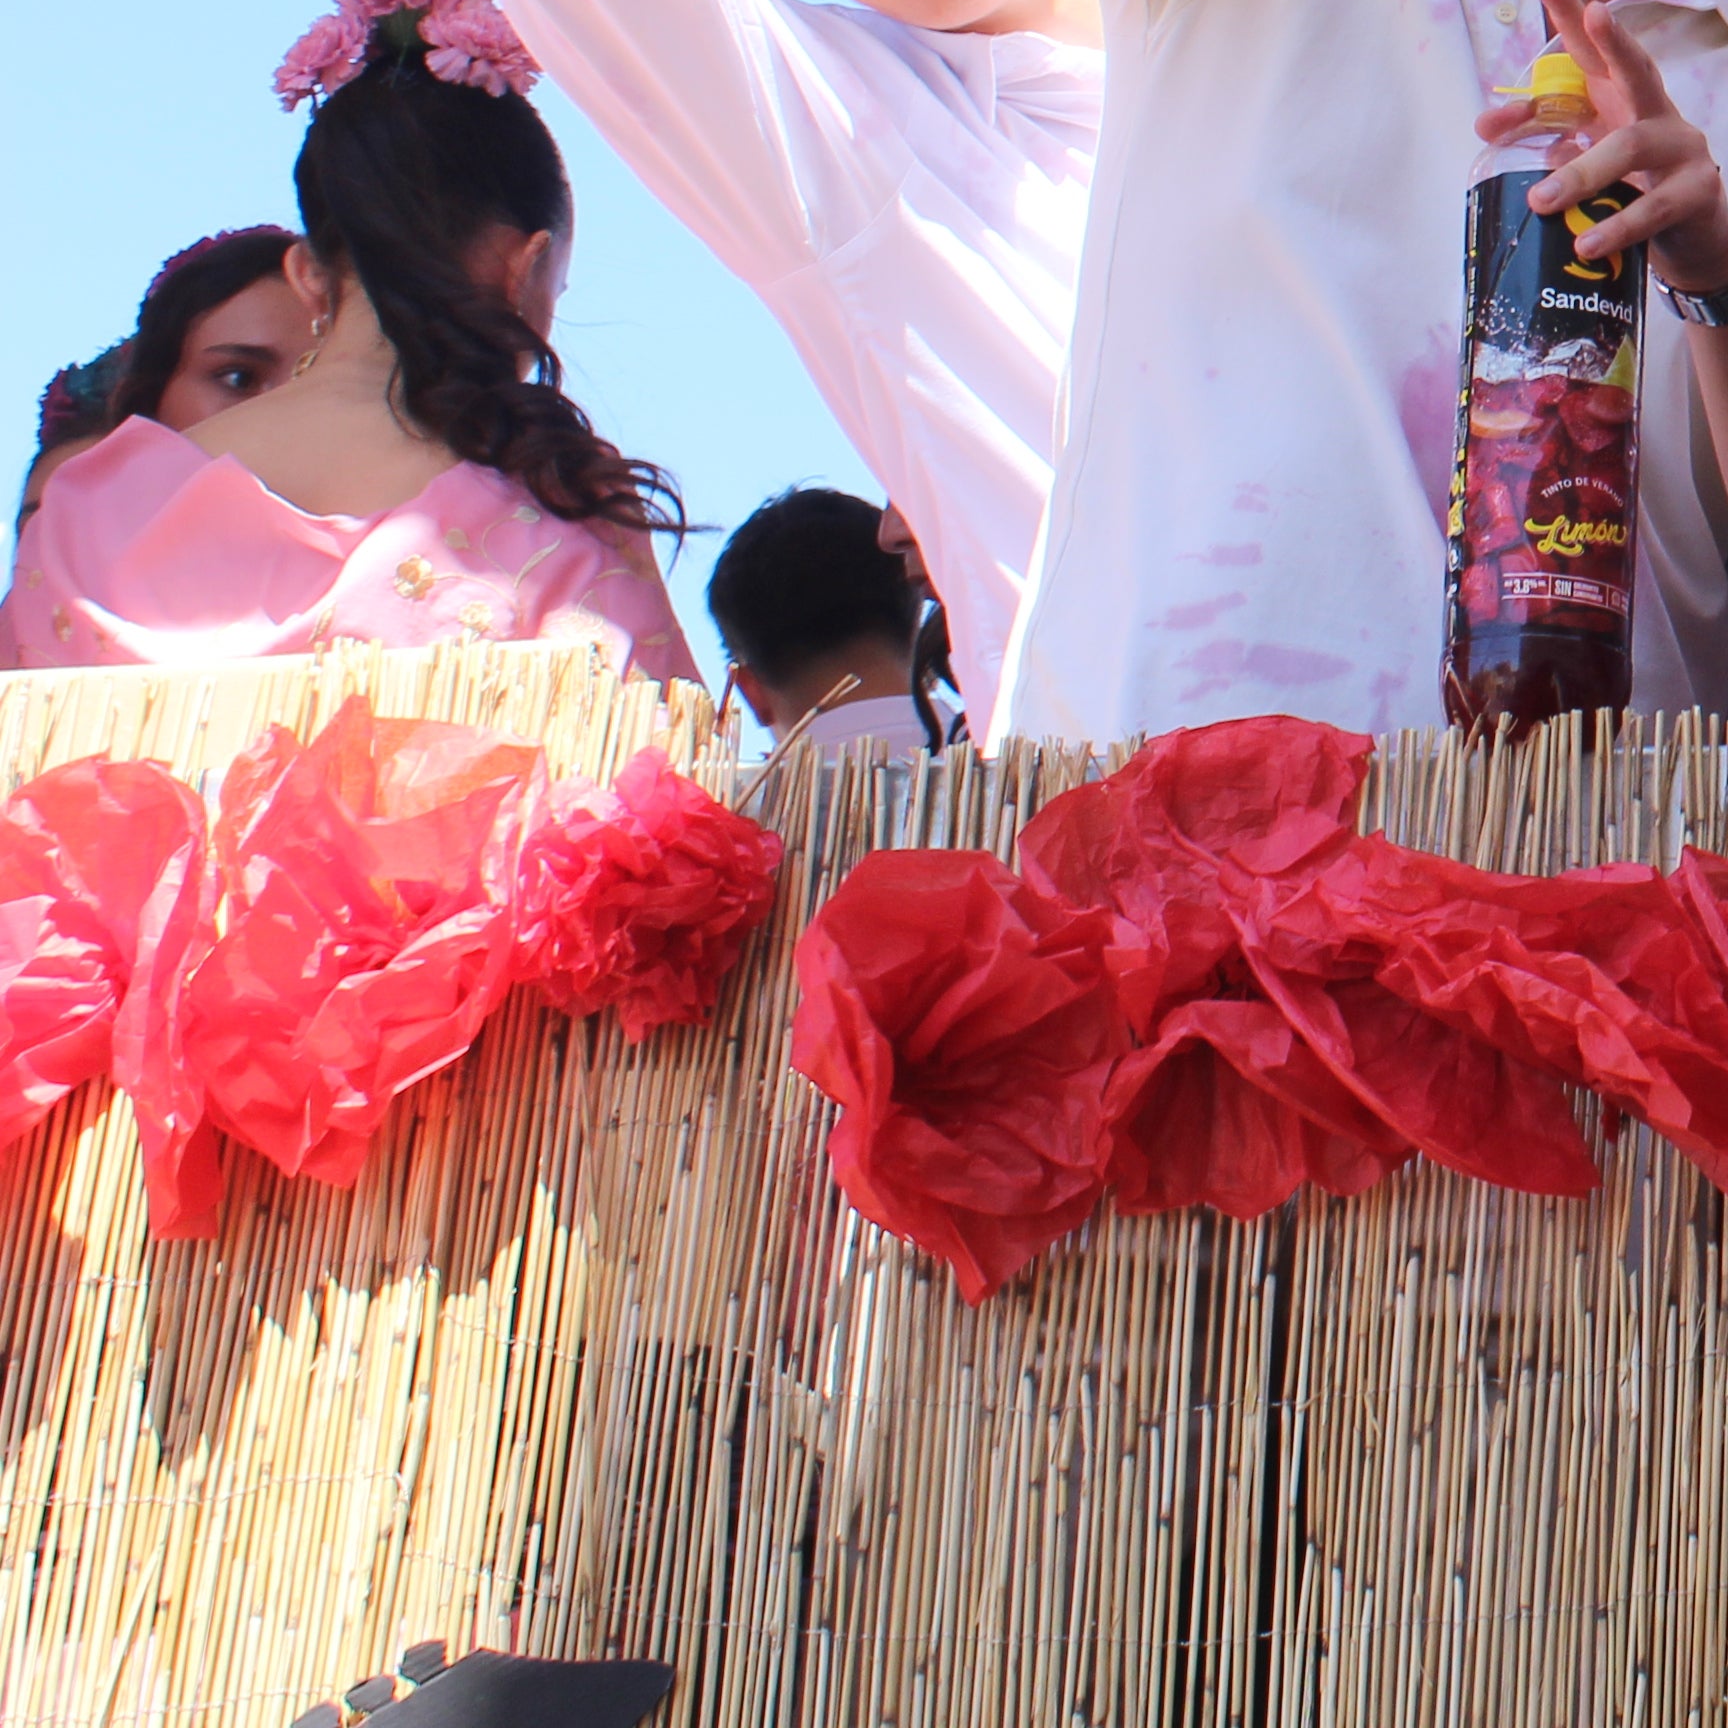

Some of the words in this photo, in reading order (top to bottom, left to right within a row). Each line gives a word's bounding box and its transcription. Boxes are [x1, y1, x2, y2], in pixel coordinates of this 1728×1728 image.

[1541, 287, 1633, 324] Sandevid
[1541, 479, 1572, 498] TINTO
[1575, 477, 1589, 486] DE
[1592, 479, 1624, 508] VERANO
[1524, 514, 1627, 557] Limón
[1555, 579, 1572, 597] SIN
